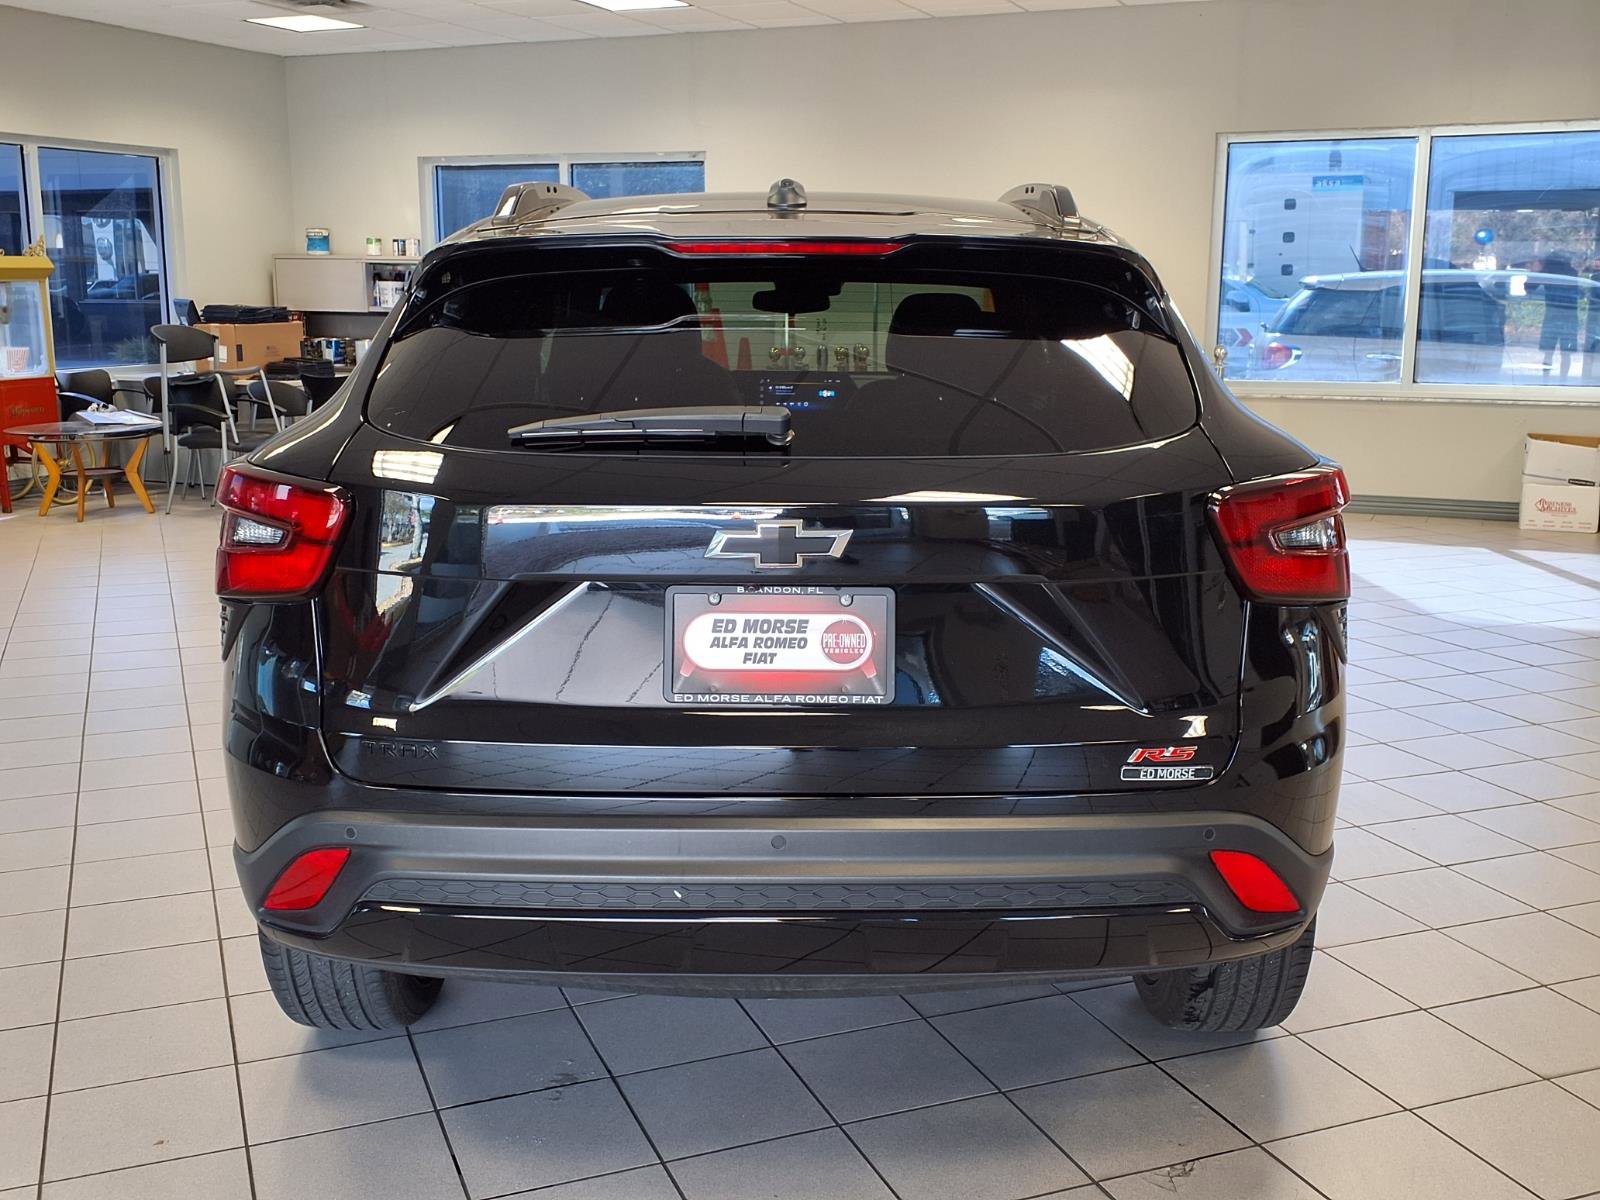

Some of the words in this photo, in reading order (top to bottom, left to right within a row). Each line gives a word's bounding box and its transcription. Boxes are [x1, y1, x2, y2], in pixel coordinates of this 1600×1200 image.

[807, 586, 824, 594] FL
[712, 619, 736, 634] ED
[742, 619, 810, 634] MORSE
[709, 637, 748, 649] ALFA
[753, 637, 808, 649] ROMEO
[823, 633, 866, 648] PRE-OWNED
[742, 652, 777, 665] FIAT
[674, 694, 693, 703] ED
[698, 694, 749, 703] MORSE
[754, 694, 791, 704] ALFA
[796, 695, 848, 704] ROMEO
[852, 695, 884, 704] FIAT
[361, 740, 439, 760] TRAX
[1127, 745, 1198, 763] RS
[1140, 768, 1155, 779] ED
[1157, 768, 1196, 779] MORSE
